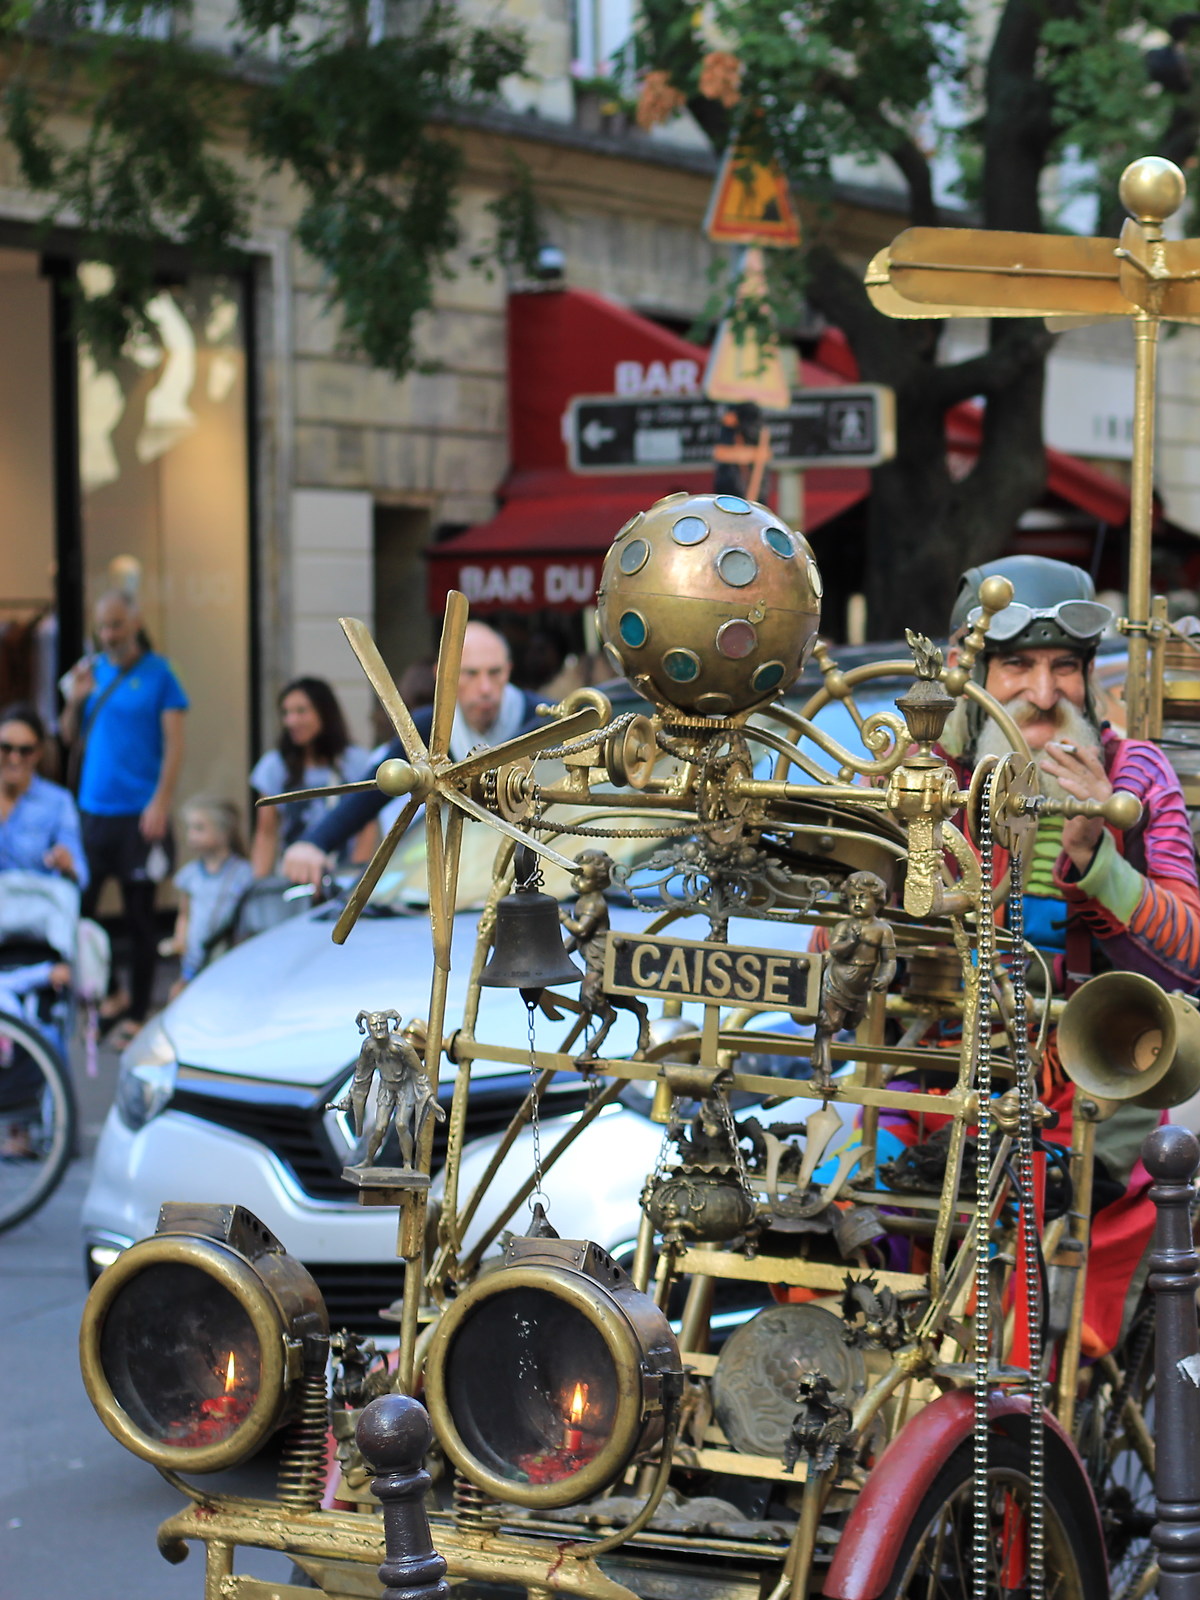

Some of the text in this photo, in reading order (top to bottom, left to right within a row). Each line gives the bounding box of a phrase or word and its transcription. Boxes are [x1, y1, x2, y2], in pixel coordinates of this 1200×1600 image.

[615, 360, 699, 397] BAR
[459, 565, 595, 603] BAR DU
[631, 943, 791, 1003] CAISSE
